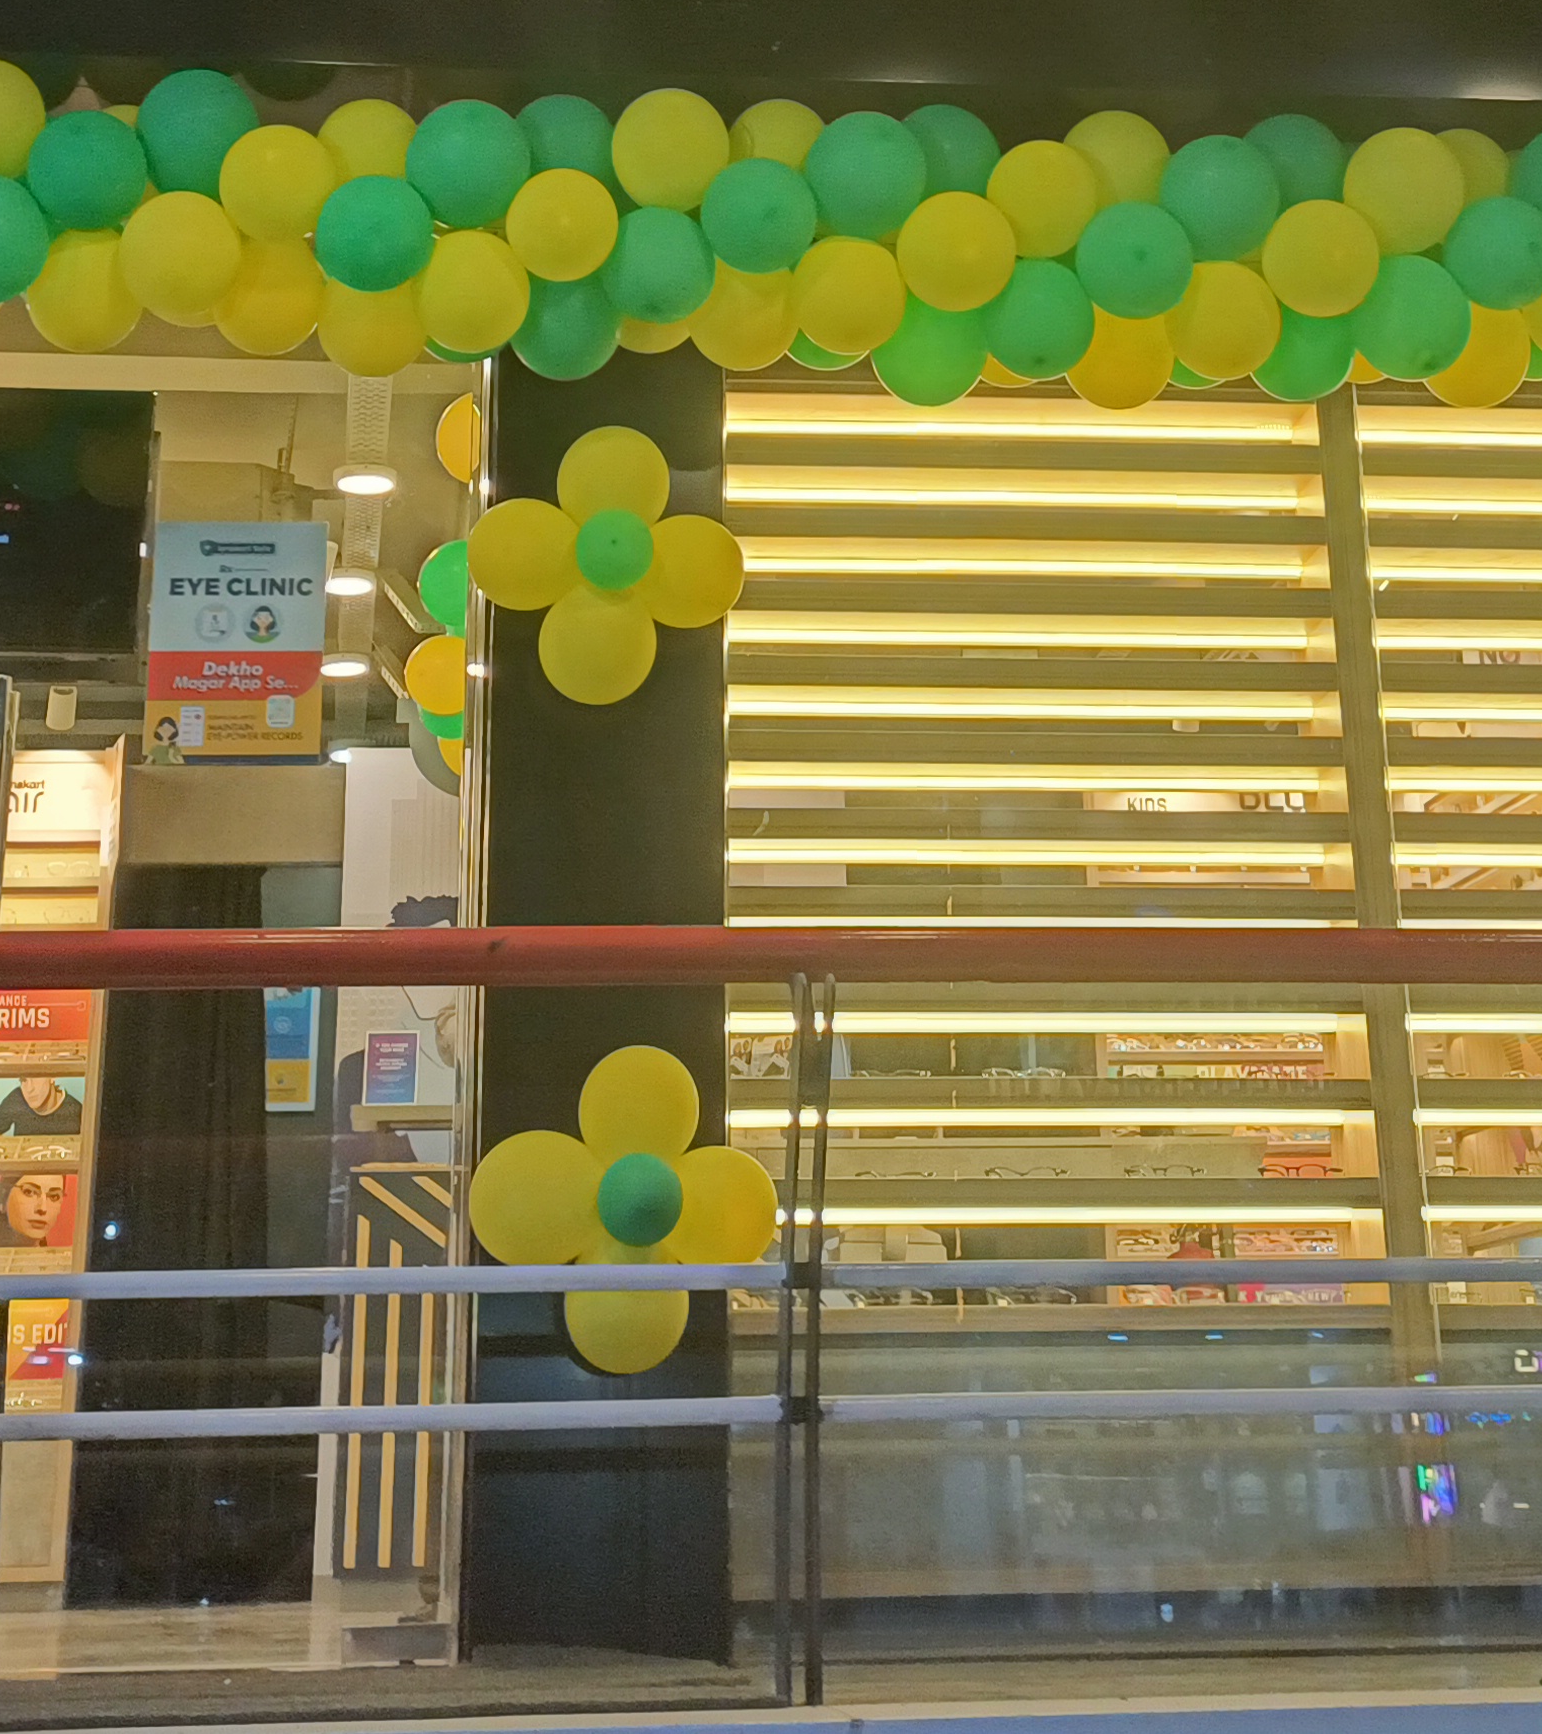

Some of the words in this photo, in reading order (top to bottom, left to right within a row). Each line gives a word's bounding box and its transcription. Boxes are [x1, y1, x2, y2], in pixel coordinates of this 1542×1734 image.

[168, 577, 221, 597] EYE
[226, 577, 314, 597] CLINIC
[202, 660, 263, 677] Dekho
[172, 675, 224, 693] Magar
[228, 676, 262, 692] App
[261, 731, 303, 742] RECORDS
[9, 779, 46, 790] nskart
[1126, 797, 1167, 812] KIDS
